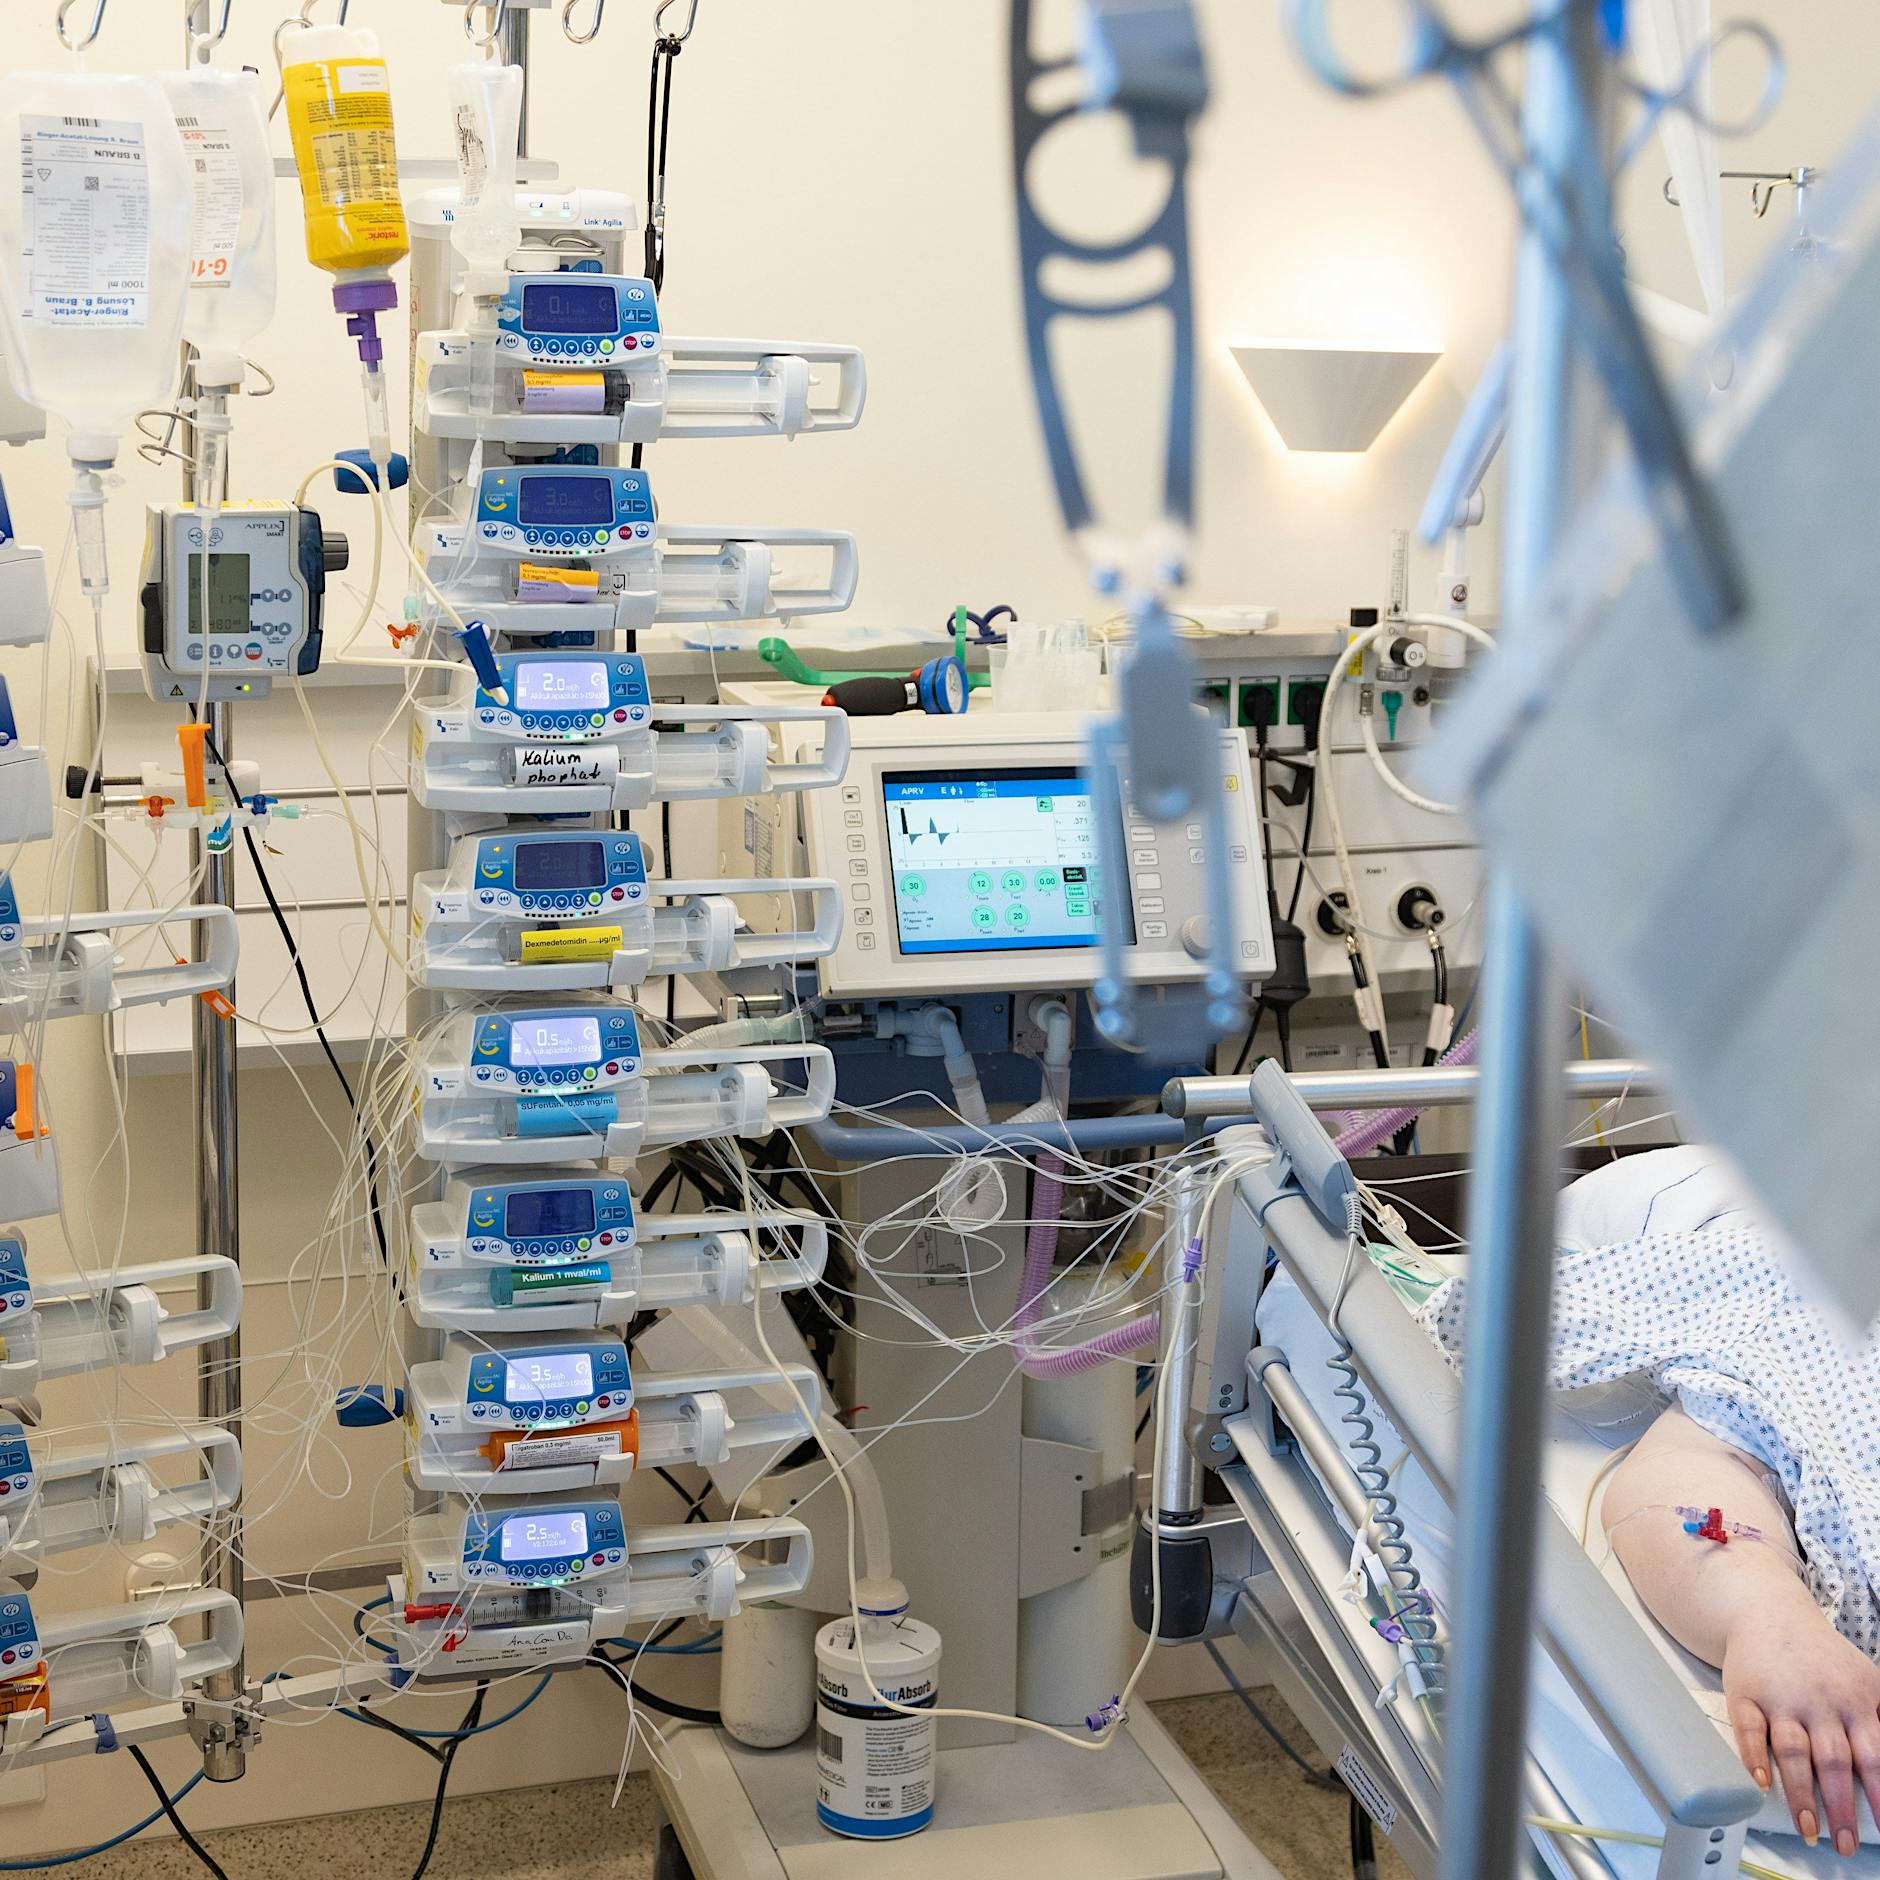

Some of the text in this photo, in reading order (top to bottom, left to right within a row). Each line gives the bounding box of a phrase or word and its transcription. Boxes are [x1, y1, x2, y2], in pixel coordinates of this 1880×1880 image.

[95, 150, 130, 159] BRAUN
[603, 219, 622, 227] Agilia
[368, 230, 399, 241] restoric
[108, 280, 144, 288] 1000 ml
[45, 296, 78, 306] Braun
[96, 296, 135, 306] Lösung
[51, 308, 129, 316] Ringer-Acetat-
[543, 672, 565, 691] 2.0
[522, 749, 581, 766] Kalium
[526, 938, 587, 948] Dexmedetomidin
[537, 1029, 558, 1046] 0.5
[521, 1100, 565, 1110] SUFentan
[587, 1097, 614, 1106] mg/ml
[522, 1273, 554, 1282] Kalium
[564, 1268, 601, 1278] mval/ml
[531, 1365, 552, 1382] 3.5
[515, 1444, 544, 1452] gatroban
[526, 1524, 547, 1540] 2.5
[513, 1596, 519, 1605] 20
[818, 1674, 848, 1698] Absorb
